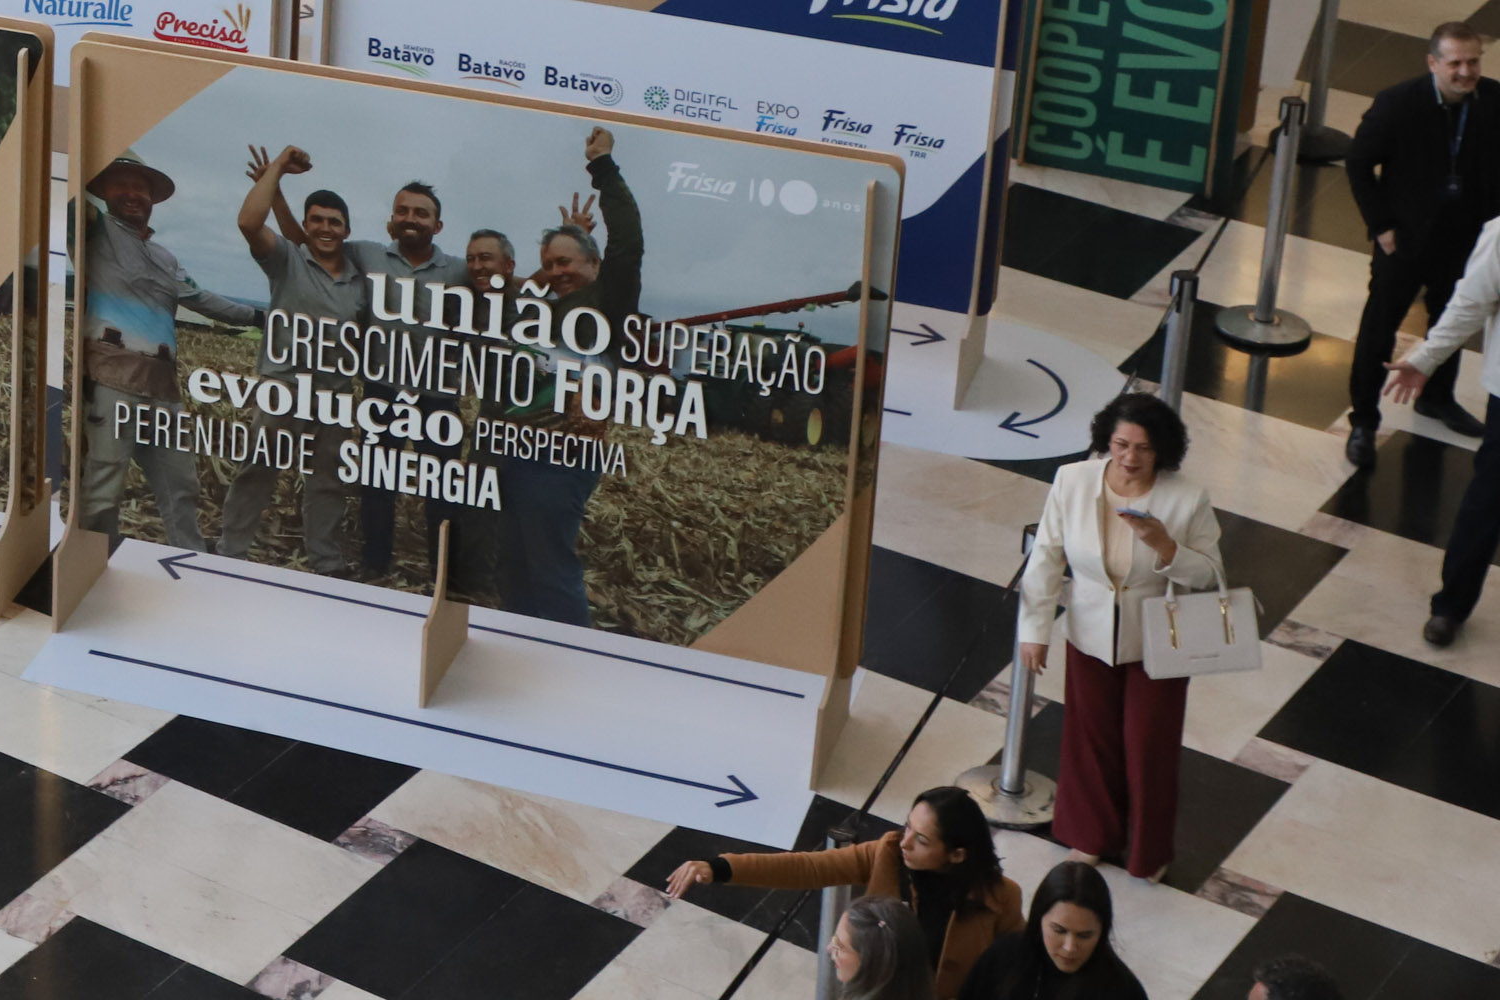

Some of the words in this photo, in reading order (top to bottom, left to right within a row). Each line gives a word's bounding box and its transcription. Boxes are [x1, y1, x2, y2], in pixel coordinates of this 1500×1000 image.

[155, 12, 247, 45] Precisa
[367, 37, 435, 67] Batavo
[457, 53, 526, 82] Batavo
[544, 65, 614, 96] Batavo
[673, 88, 740, 111] DIGITAL
[756, 100, 800, 119] EXPO
[909, 150, 928, 159] TRR
[1096, 135, 1209, 184] É
[822, 199, 861, 213] anos
[366, 271, 613, 359] união
[620, 313, 828, 399] SUPERAÇÃO
[265, 308, 537, 410] CRESCIMENTO
[553, 356, 710, 448] FORÇA
[187, 361, 465, 450] evolução
[474, 416, 629, 480] PERSPECTIVA
[113, 399, 316, 477] PERENIDADE
[337, 440, 503, 512] SINERGIA
